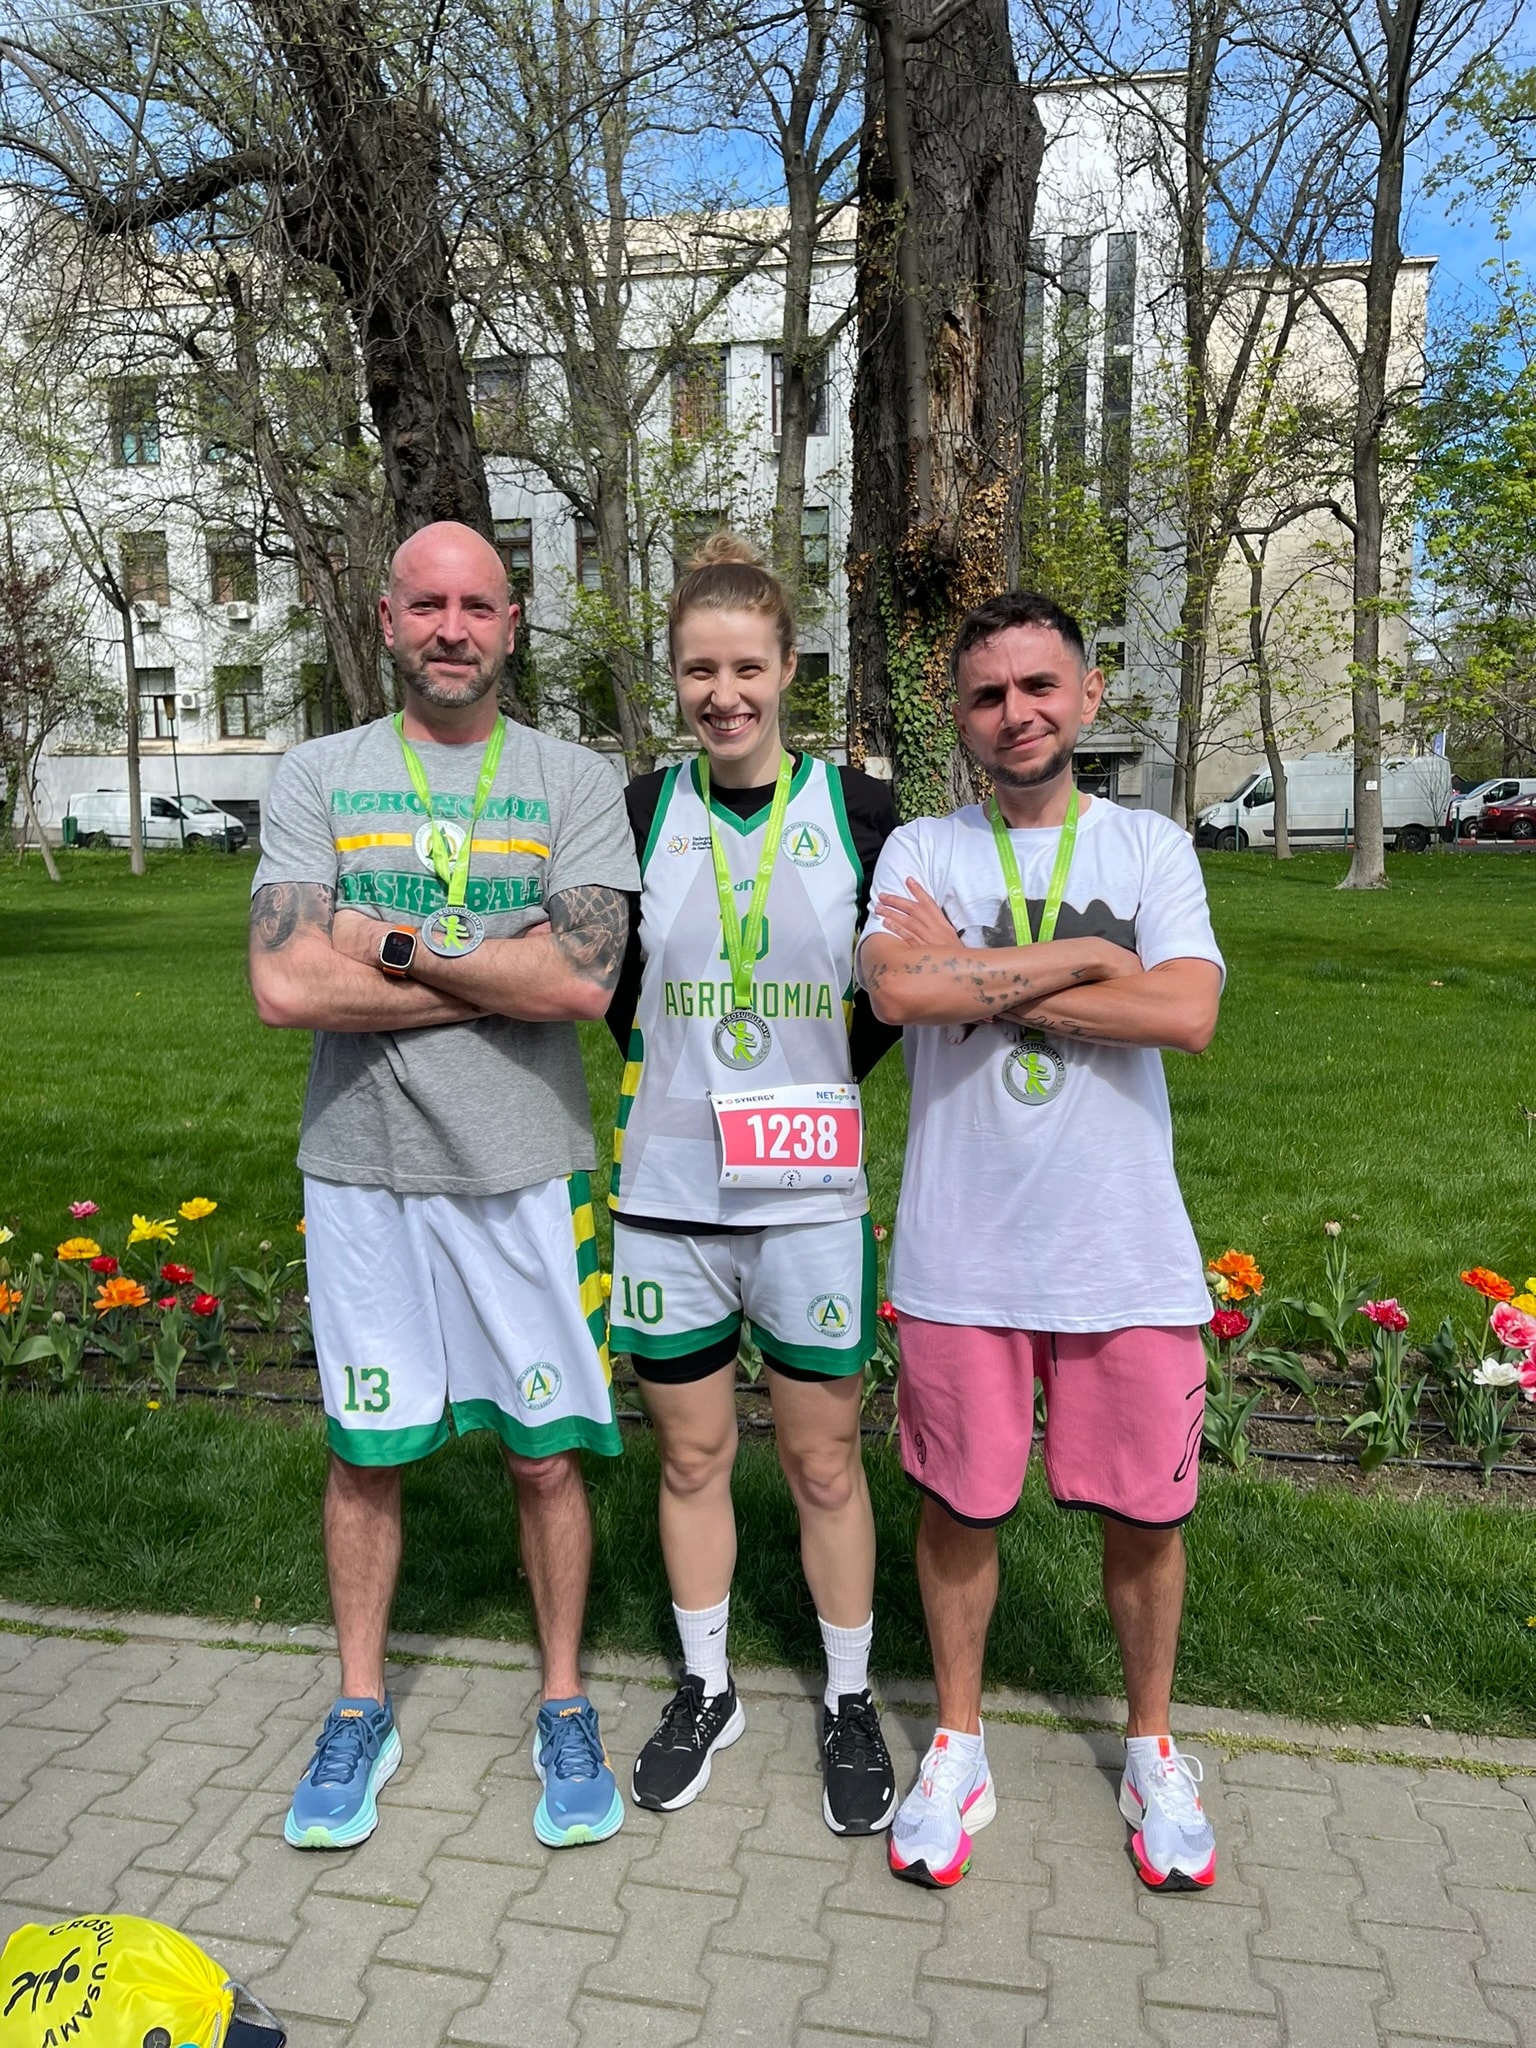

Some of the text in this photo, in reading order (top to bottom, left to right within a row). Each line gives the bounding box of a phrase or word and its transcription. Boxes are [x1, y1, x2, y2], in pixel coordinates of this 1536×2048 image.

[332, 790, 548, 823] AGRONOMIA
[339, 870, 542, 916] BASKEBALL
[722, 1012, 752, 1024] CROSUL
[734, 1094, 775, 1104] SYNERGY
[746, 1113, 838, 1160] 1238
[621, 1273, 664, 1325] 10
[343, 1364, 392, 1413] 13
[42, 1919, 114, 2048] CROSUL USAMV
